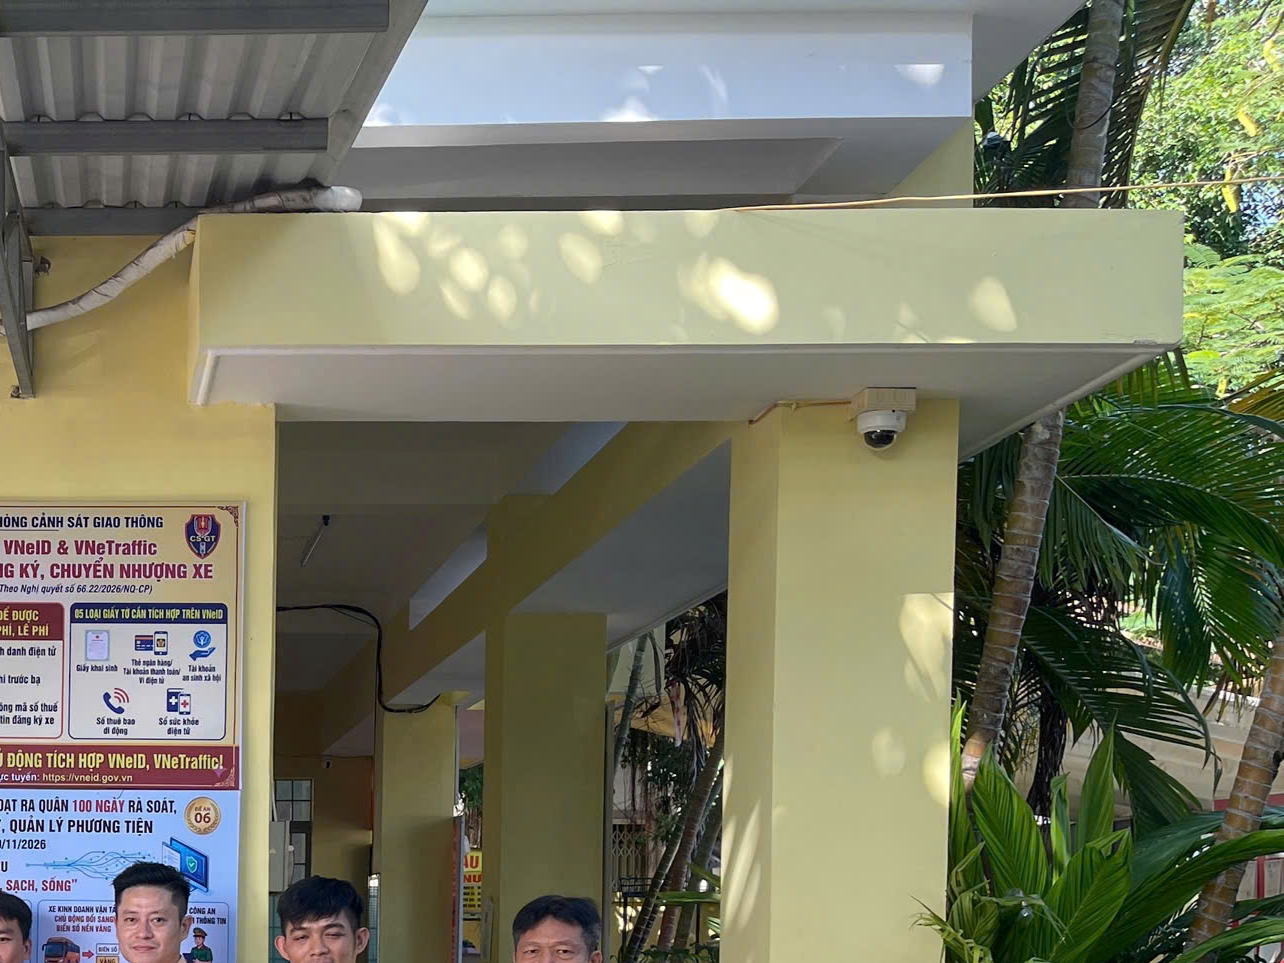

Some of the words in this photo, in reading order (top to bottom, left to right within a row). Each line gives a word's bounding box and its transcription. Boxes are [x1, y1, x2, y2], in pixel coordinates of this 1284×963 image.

[32, 513, 63, 528] CẢNH
[68, 514, 89, 528] SÁT
[93, 516, 120, 528] GIAO
[124, 514, 163, 528] THÔNG
[4, 540, 51, 554] VNeID
[57, 540, 68, 554] &
[74, 540, 157, 555] VNeTraffic
[21, 584, 38, 594] Nghị
[41, 584, 62, 594] quyết
[65, 584, 74, 593] số
[76, 584, 152, 594] 66.22/2026/NQ-CP)
[7, 647, 26, 656] danh
[29, 647, 45, 658] điện
[48, 646, 56, 656] tử
[12, 771, 40, 782] tuyến:
[42, 773, 132, 783] https://vneid.gov.vn
[195, 812, 211, 823] 06
